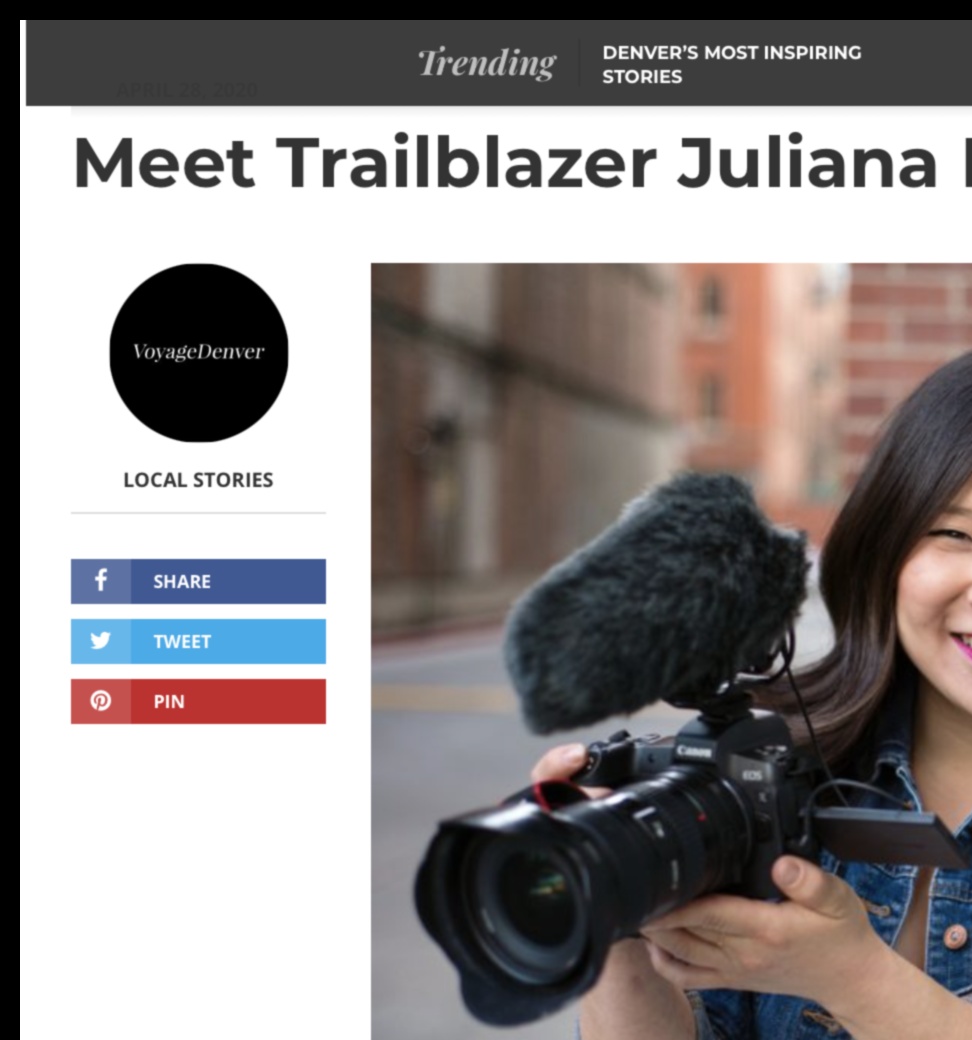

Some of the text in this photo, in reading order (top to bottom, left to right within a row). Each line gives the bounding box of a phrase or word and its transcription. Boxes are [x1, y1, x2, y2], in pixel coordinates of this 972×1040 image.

[603, 45, 861, 60] DENVER’S MOST INSPIRING
[419, 46, 557, 82] Trending
[603, 69, 682, 84] STORIES
[76, 138, 255, 188] Meet
[276, 132, 657, 188] Trailblazer
[677, 132, 936, 188] Juliana
[134, 344, 265, 362] VoyageDenver
[124, 472, 273, 488] LOCAL STORIES
[154, 574, 210, 589] SHARE
[154, 635, 211, 648] TWEET
[155, 695, 184, 708] PIN
[676, 744, 713, 758] Canon
[742, 769, 763, 781] EOS
